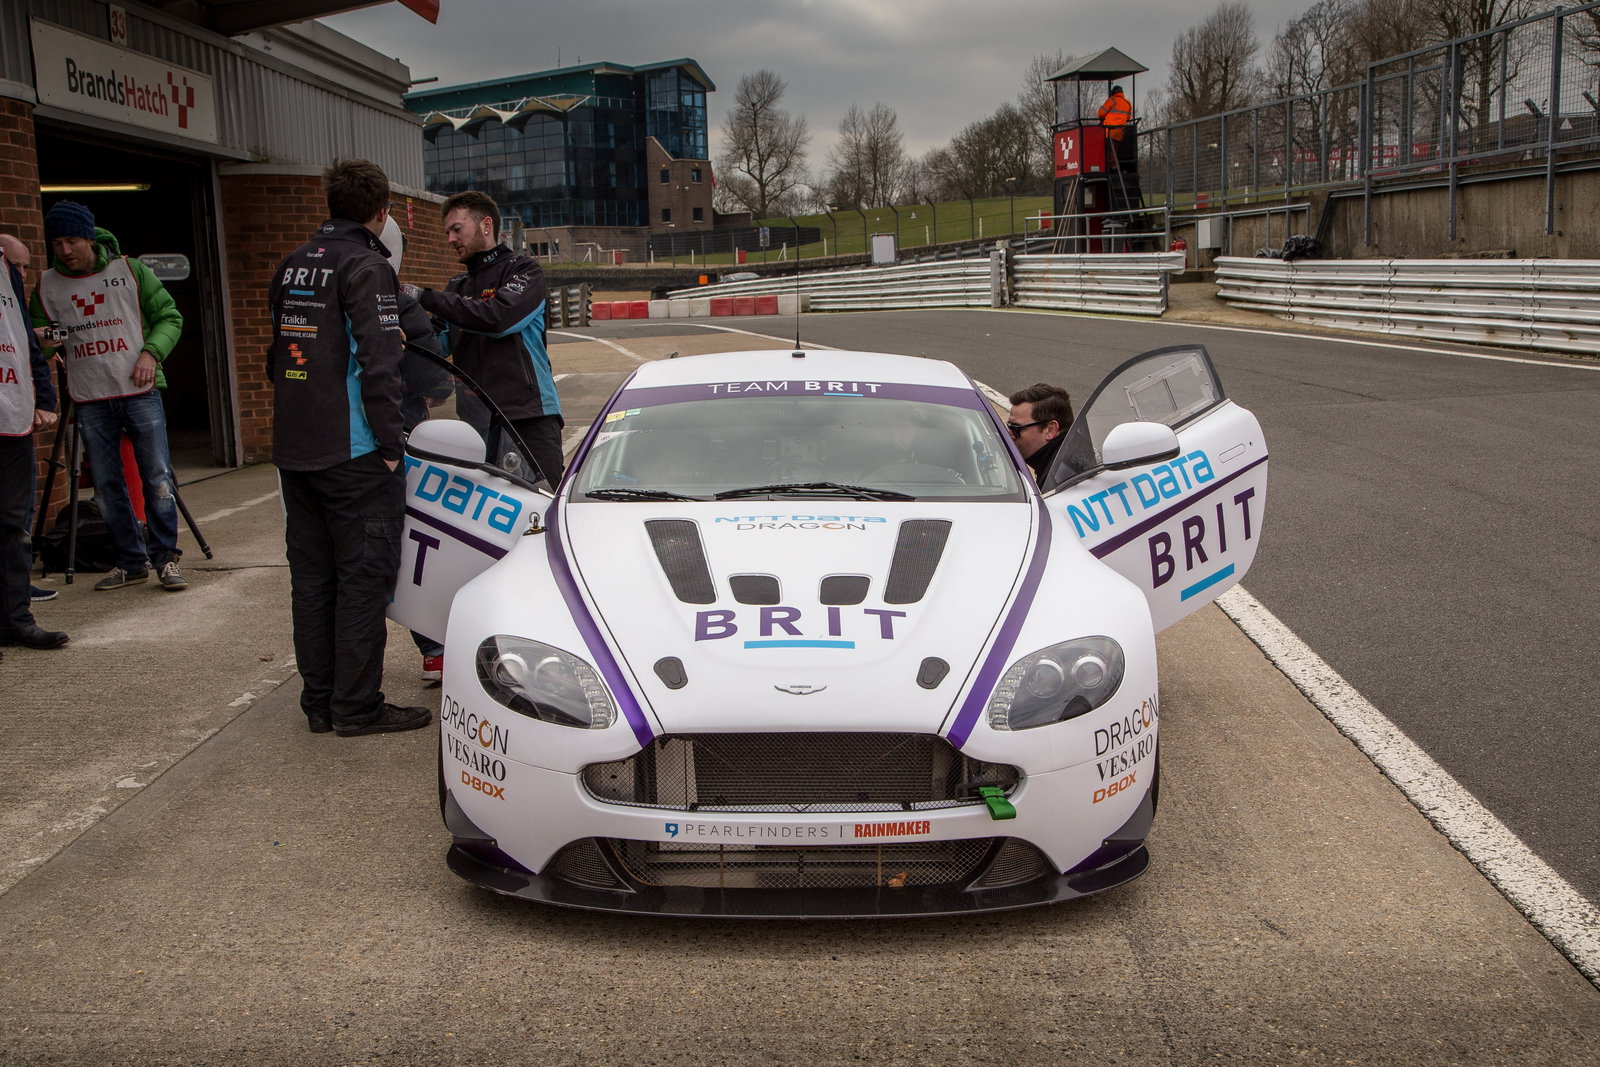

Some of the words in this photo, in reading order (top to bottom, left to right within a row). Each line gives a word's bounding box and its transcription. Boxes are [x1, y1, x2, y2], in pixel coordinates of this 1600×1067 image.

[111, 10, 126, 40] 33
[65, 57, 168, 116] BrandsHatch
[102, 277, 127, 288] 161
[281, 267, 334, 287] BRIT
[67, 316, 123, 334] BrandsHatch
[281, 313, 307, 325] Fraikin
[74, 337, 128, 359] MEDIA
[708, 381, 788, 394] TEAM
[804, 381, 882, 394] BRIT
[714, 515, 785, 523] NTT
[1066, 481, 1129, 538] NTT
[737, 523, 865, 531] DRAGON
[1148, 486, 1255, 590] BRIT
[695, 606, 907, 642] BRIT
[441, 694, 509, 755] DRAGON
[1094, 692, 1158, 757] DRAGON
[447, 732, 506, 782] VESARO
[1096, 733, 1153, 782] VESARO
[685, 823, 829, 838] PEARLFINDERS
[854, 820, 931, 838] RAINMAKER
